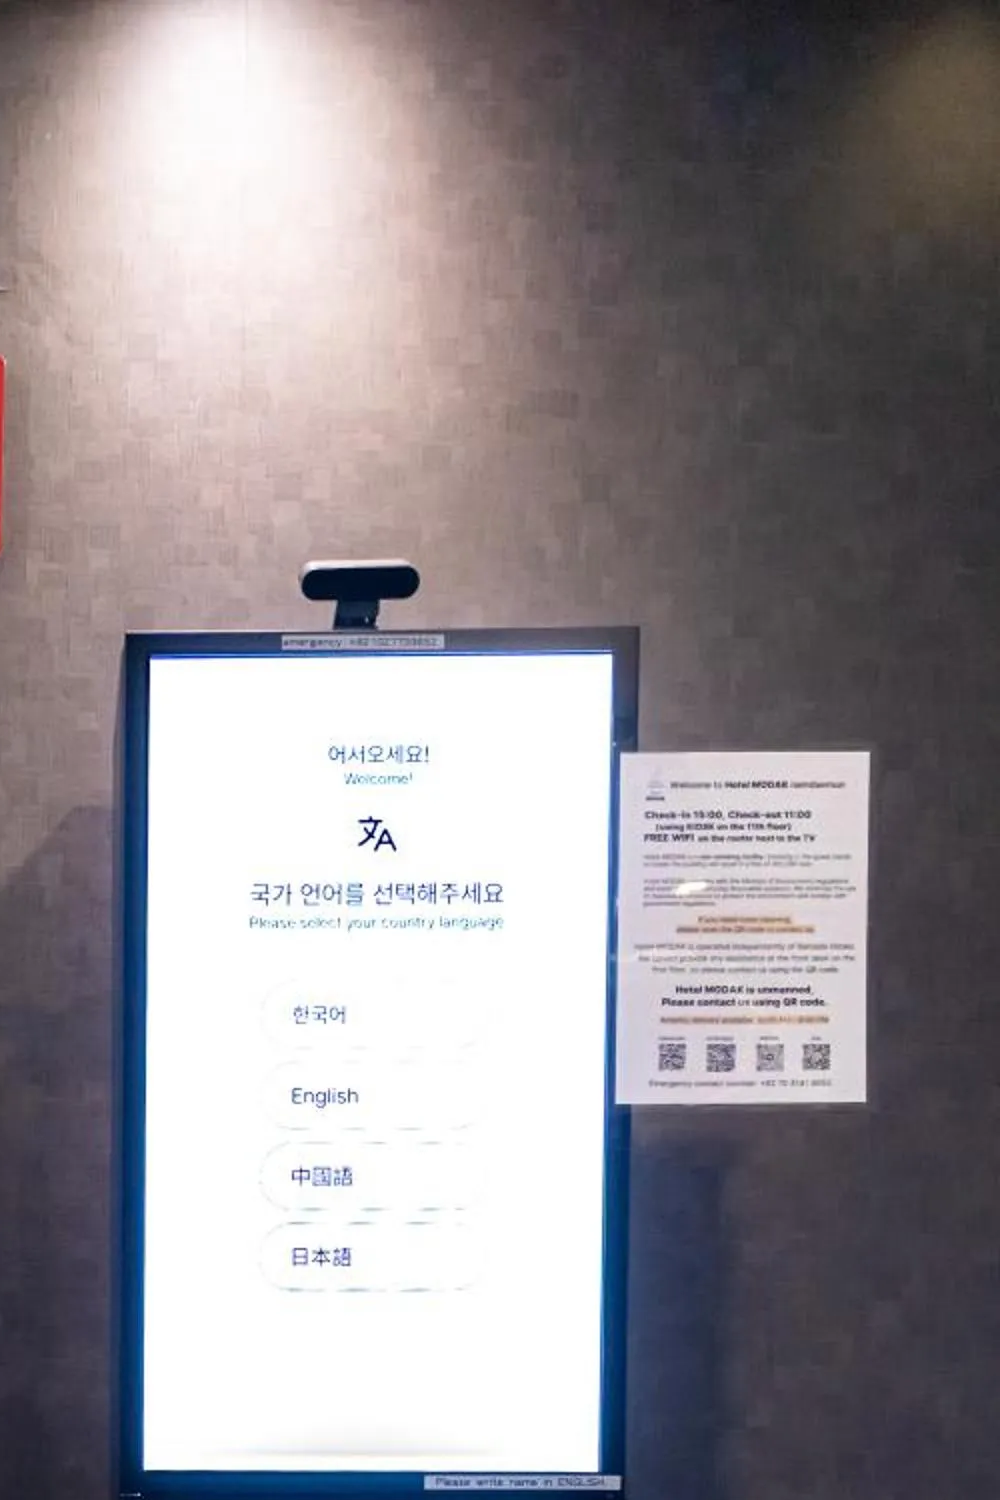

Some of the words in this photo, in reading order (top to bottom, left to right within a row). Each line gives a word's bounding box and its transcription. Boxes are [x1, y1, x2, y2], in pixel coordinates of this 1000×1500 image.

[328, 745, 429, 764] 어서오세요!
[344, 772, 413, 785] Welcome!
[644, 810, 691, 819] Check-in
[727, 810, 781, 819] Check-out
[643, 833, 668, 842] FREE
[250, 884, 292, 904] 국가
[300, 884, 365, 905] 언어를
[374, 883, 503, 905] 선택해주세요
[249, 916, 296, 928] Please
[300, 916, 341, 928] select
[346, 918, 376, 931] your
[381, 916, 434, 931] country
[439, 916, 504, 931] language
[675, 985, 702, 994] Hotel
[746, 985, 754, 994] is
[661, 998, 694, 1007] Please
[697, 998, 736, 1007] contact
[752, 998, 781, 1009] using
[293, 1005, 346, 1024] 한국어
[291, 1087, 359, 1108] English
[291, 1247, 352, 1267] 日本語
